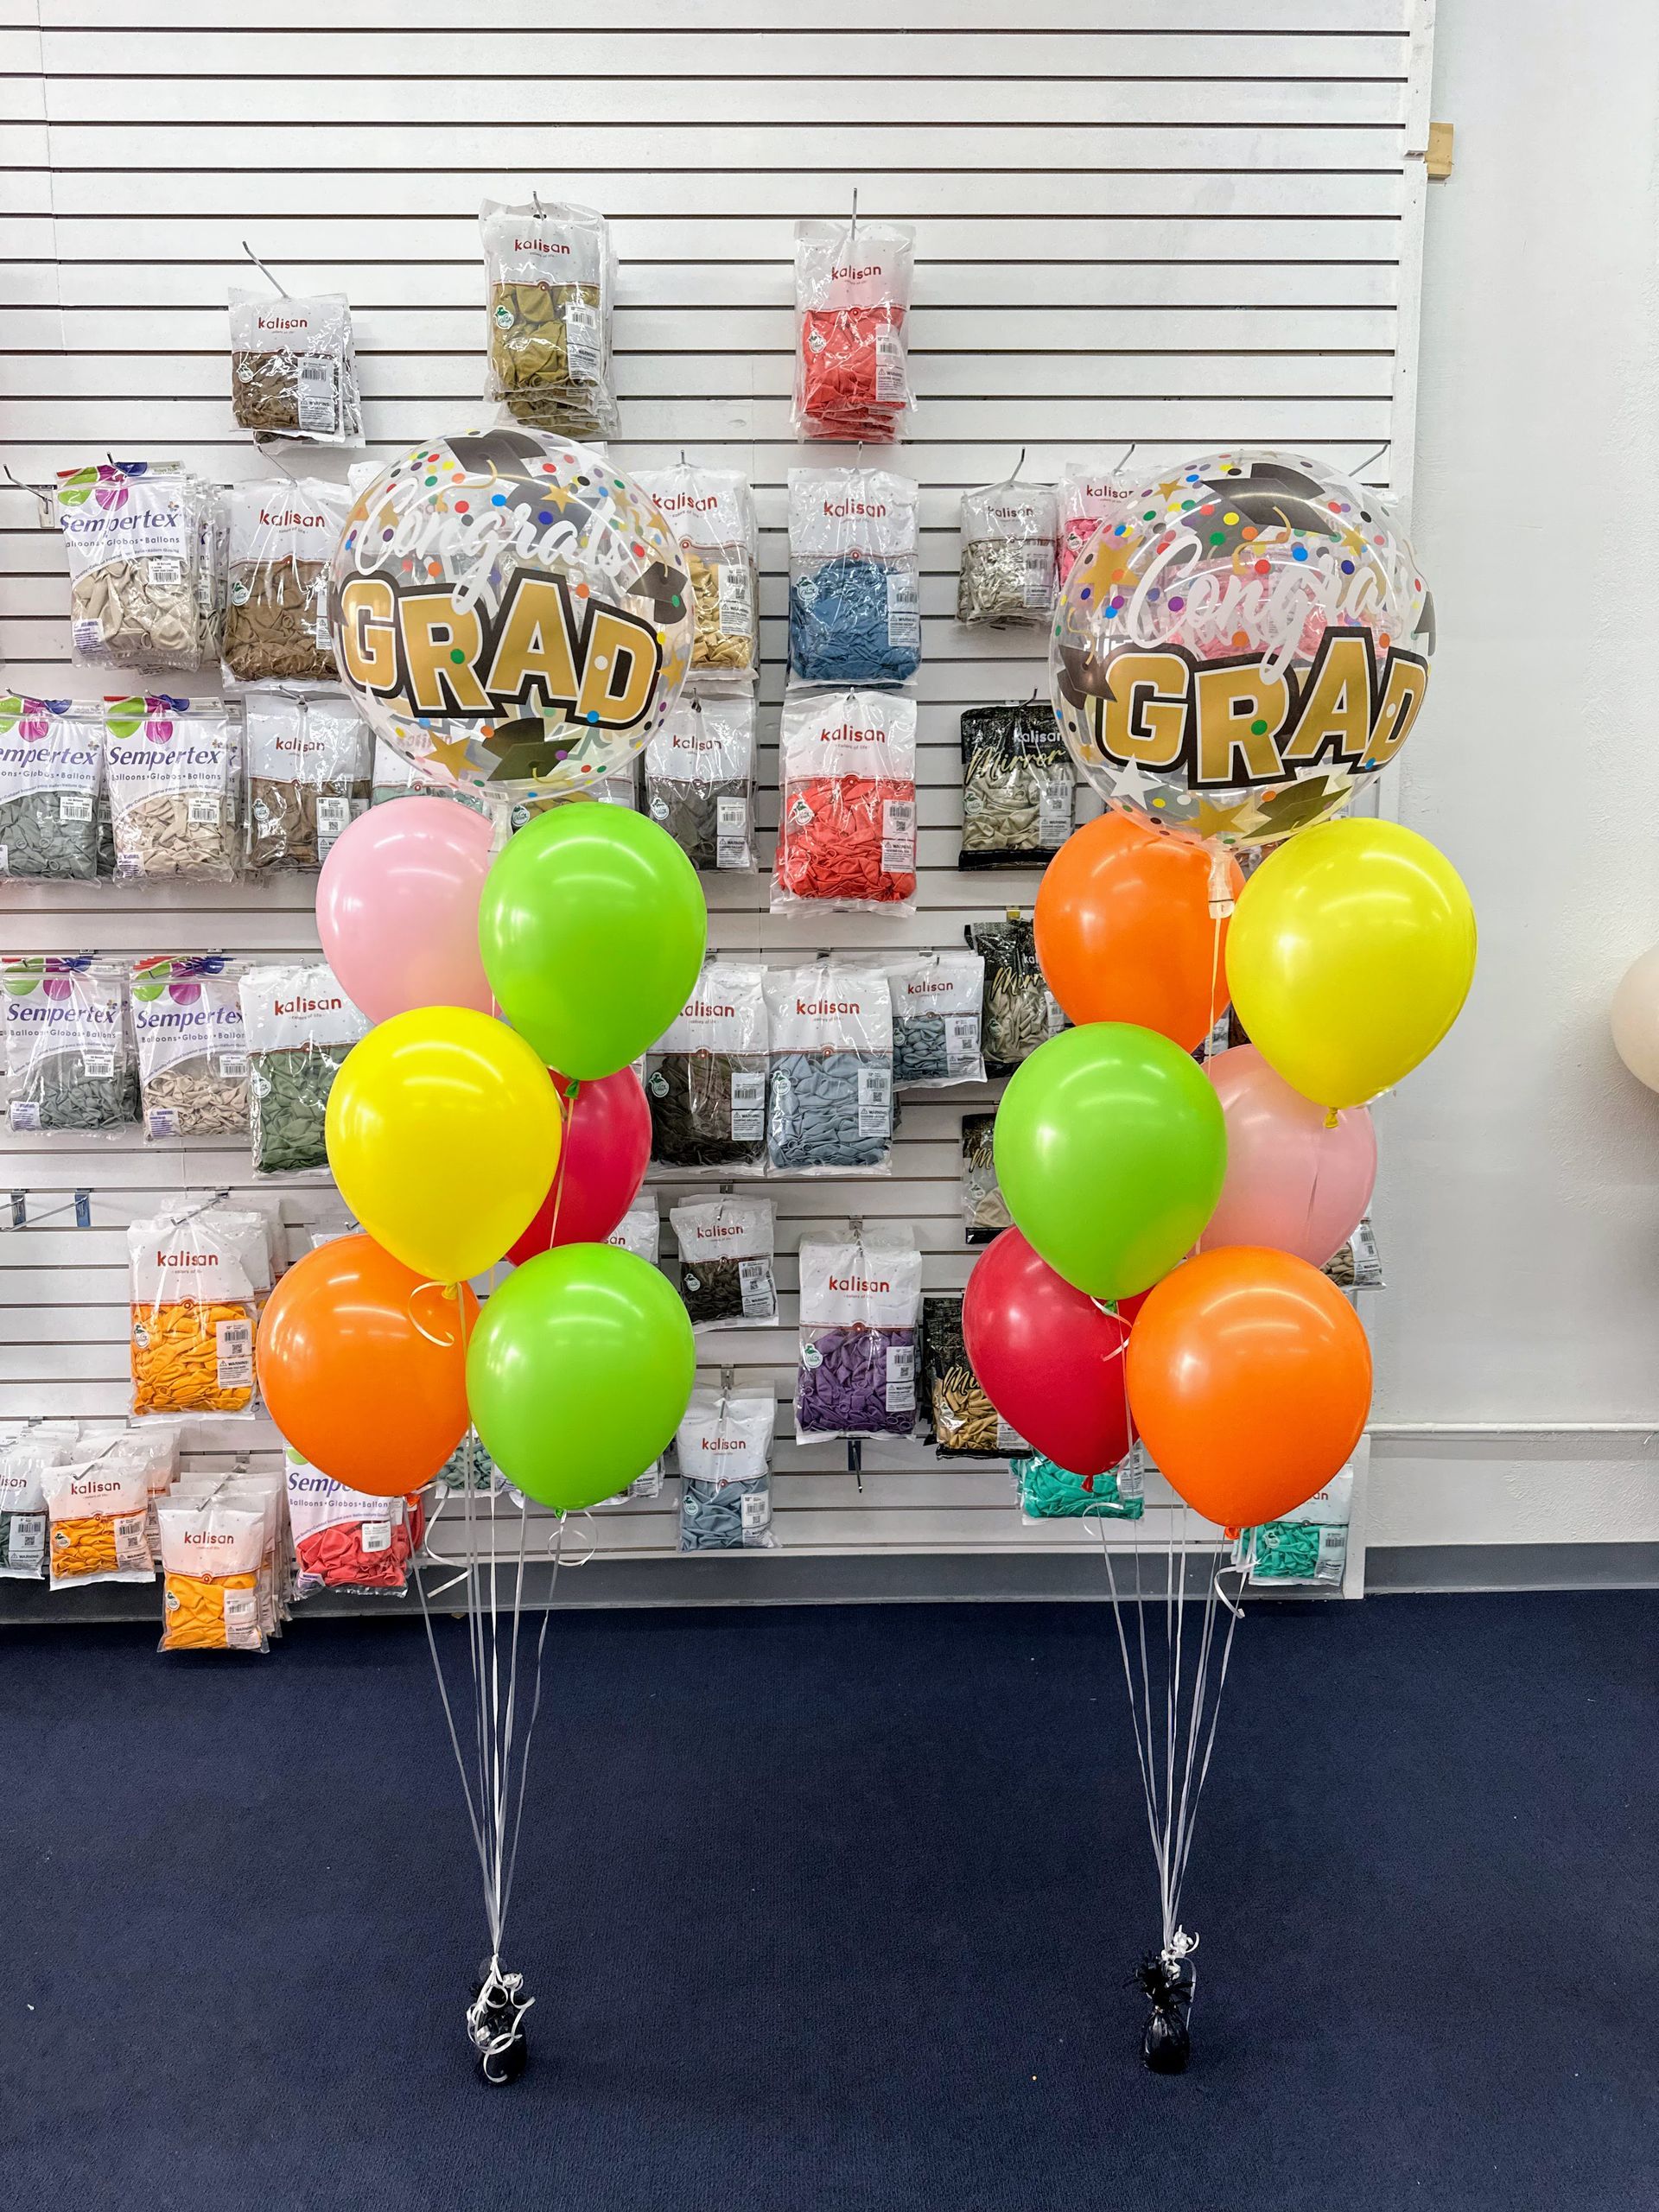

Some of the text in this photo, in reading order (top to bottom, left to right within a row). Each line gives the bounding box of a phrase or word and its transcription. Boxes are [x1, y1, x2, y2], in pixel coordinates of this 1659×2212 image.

[513, 238, 570, 256] kalisan
[831, 264, 881, 281] kalisan
[257, 316, 308, 330] kalisan
[652, 493, 717, 512] kalisan
[823, 498, 887, 518] kalisan
[60, 510, 179, 538] Sempertex
[260, 509, 325, 528] kalisan
[145, 536, 181, 544] Ballons
[353, 476, 632, 615] Congrats
[337, 569, 662, 729] GRAD
[1097, 628, 1431, 789] GRAD
[821, 724, 885, 743] kalisan
[276, 735, 325, 753] kalisan
[672, 735, 722, 751] kalisan
[0, 747, 95, 768] mpertex
[109, 747, 221, 771] Sempertex
[964, 745, 1066, 785] Mirror
[60, 772, 96, 780] Ballons
[907, 981, 953, 995] kalisan
[990, 966, 1046, 1001] Mirr
[7, 1003, 118, 1027] Sempertex
[275, 996, 342, 1016] kalisan
[796, 999, 860, 1015] kalisan
[137, 1007, 243, 1032] Sempertex
[141, 1035, 177, 1044] Balloons
[182, 1033, 215, 1041] Globo
[697, 1224, 743, 1238] kalisan
[157, 1250, 219, 1267] kalisan
[829, 1275, 890, 1293] kalisan
[702, 1437, 747, 1451] kalisan
[71, 1481, 121, 1495] kalisan
[289, 1498, 323, 1507] Balloons
[184, 1531, 234, 1544] kalisan
